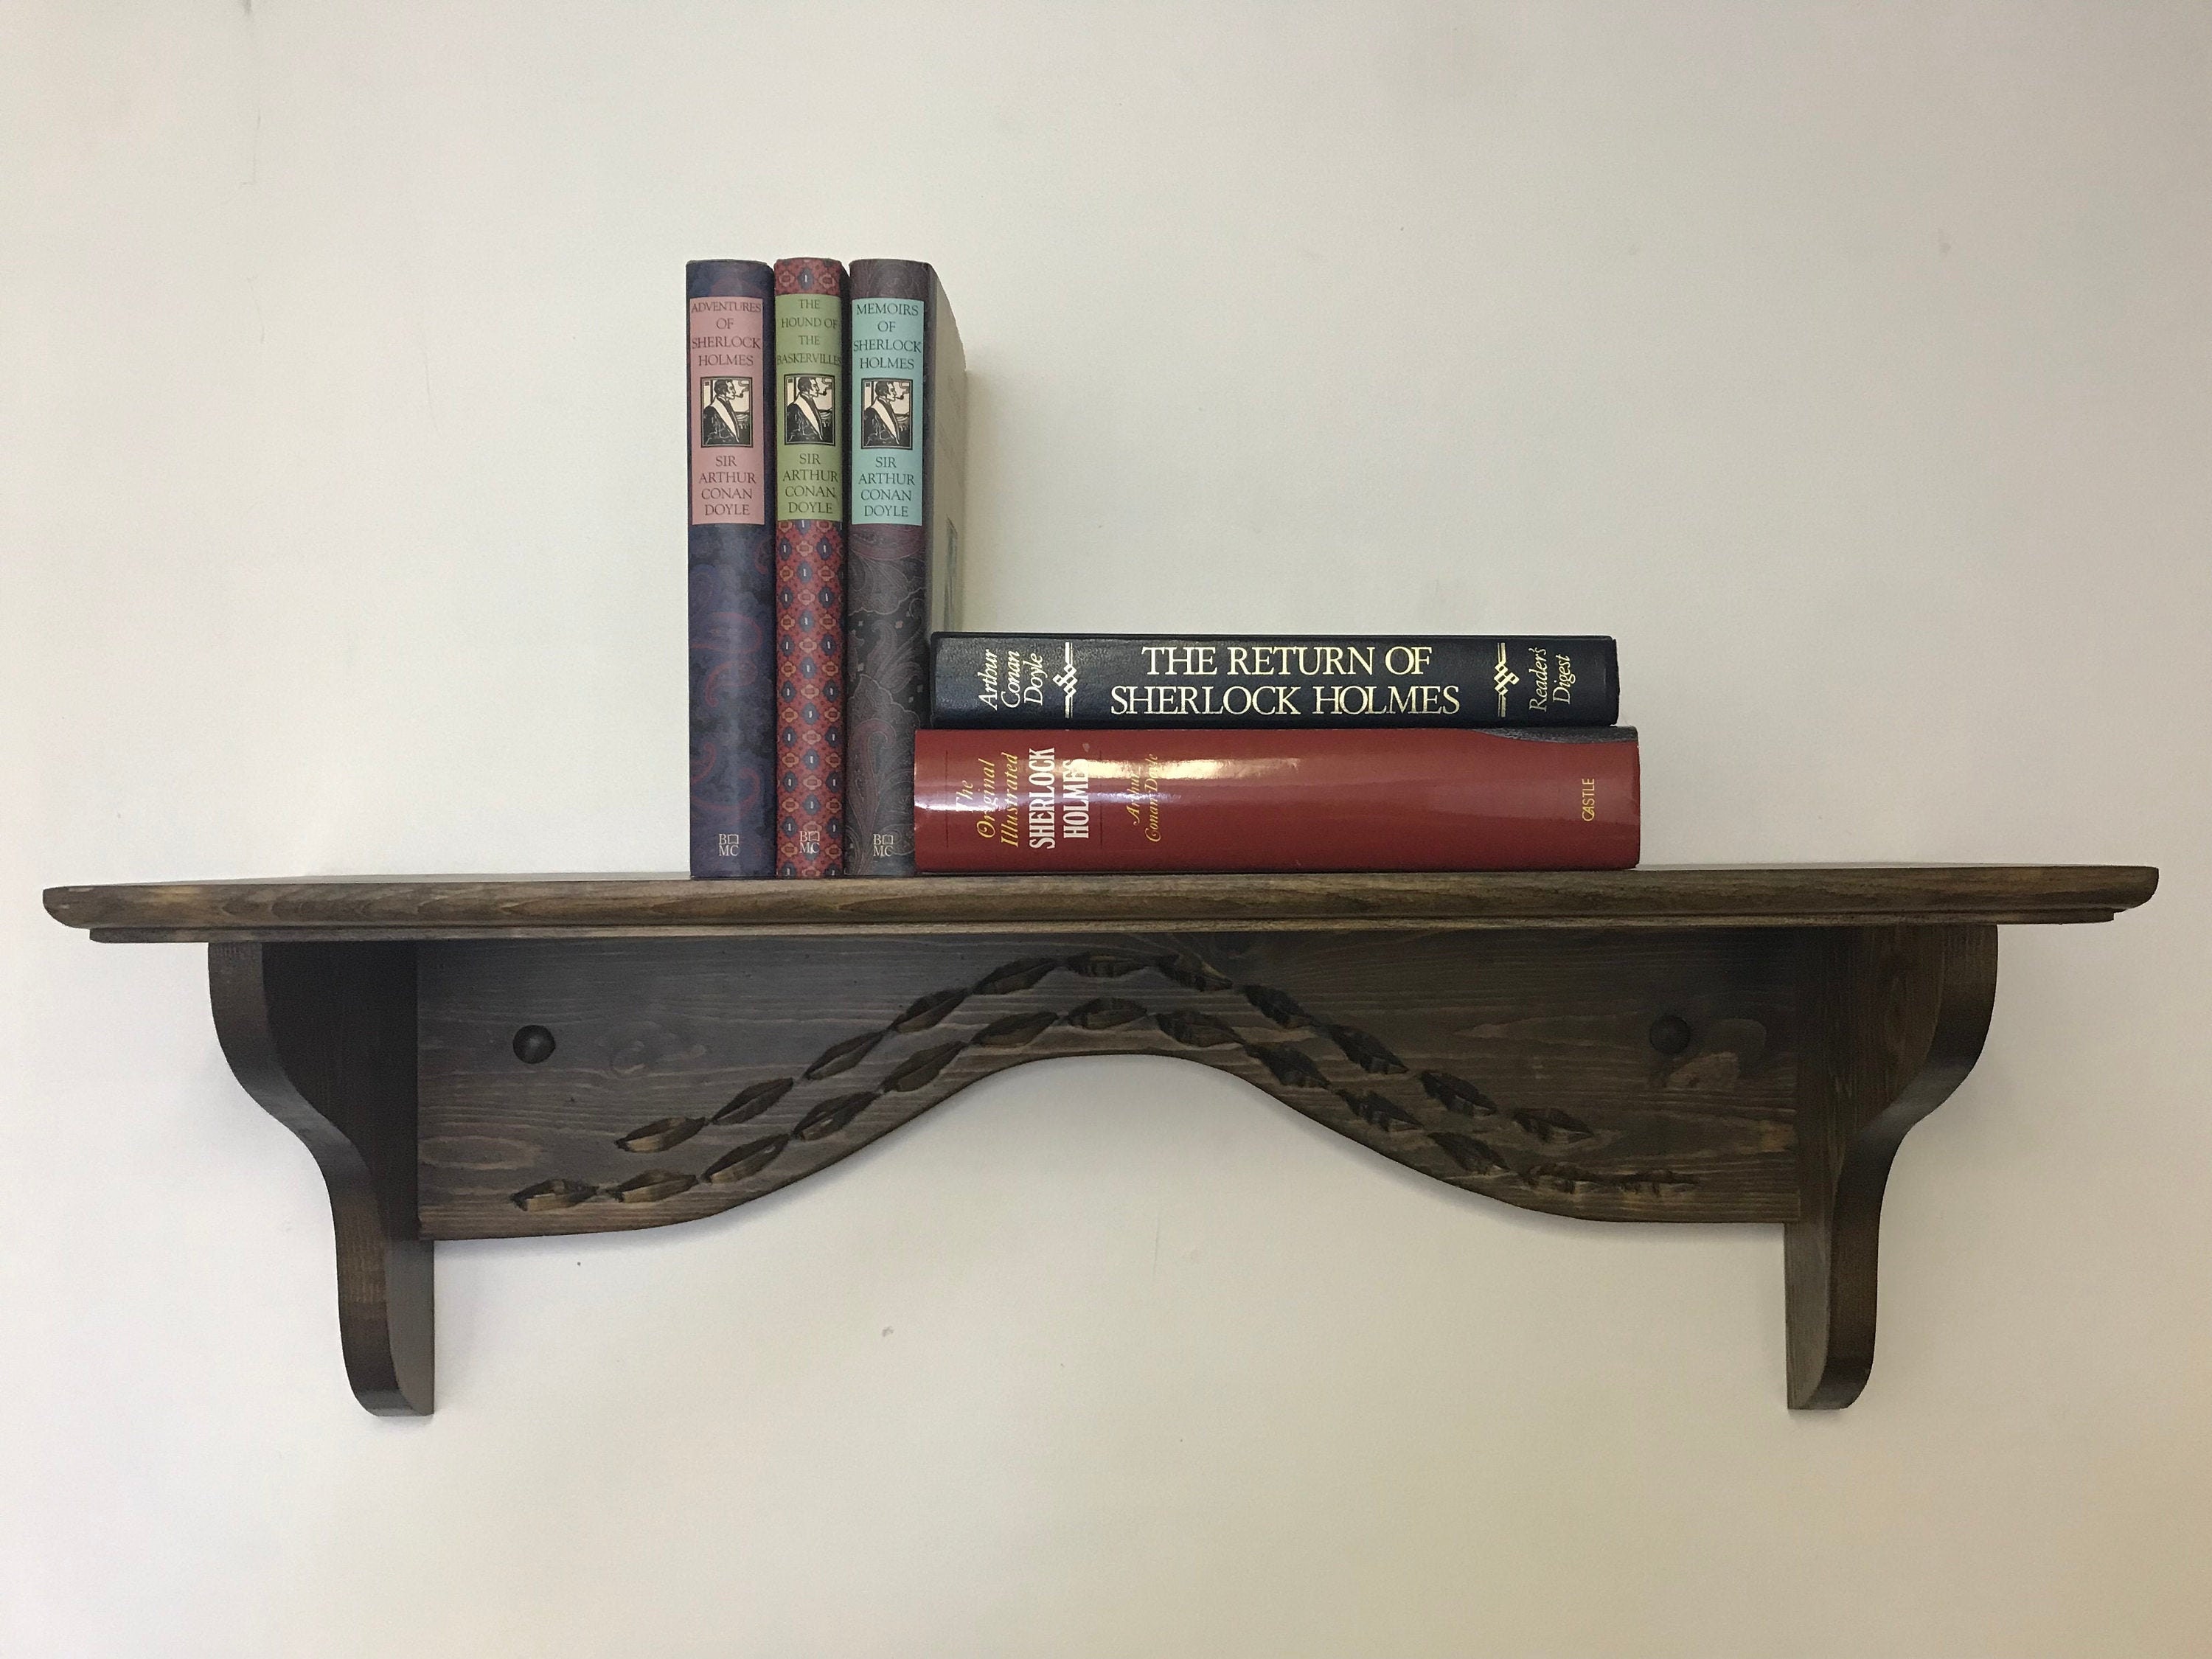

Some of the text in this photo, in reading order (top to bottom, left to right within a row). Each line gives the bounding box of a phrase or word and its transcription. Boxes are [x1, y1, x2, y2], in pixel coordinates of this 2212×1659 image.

[691, 302, 762, 313] ADVENTURES
[799, 299, 820, 309] THE
[856, 303, 919, 316] MEMOIRS
[716, 319, 734, 330] OF
[782, 317, 838, 328] HOUND OF
[877, 321, 896, 332] OF
[692, 336, 761, 349] SHERLOCK
[799, 335, 820, 345] THE
[854, 340, 922, 352] SHERLOCK
[698, 355, 754, 366] HOLMES
[776, 354, 842, 366] BASKERVILLES
[860, 358, 914, 369] HOLMES
[715, 455, 737, 467] SIR
[799, 453, 821, 465] SIR
[875, 456, 897, 467] SIR
[700, 472, 756, 484] ARTHUR
[782, 470, 838, 481] ARTHUR
[858, 473, 915, 485] ARTHUR
[701, 488, 752, 499] CONAN
[785, 486, 835, 498] CONAN
[860, 490, 911, 501] CONAN
[705, 504, 750, 515] DOYLE
[788, 502, 832, 513] DOYLE
[864, 506, 908, 517] DOYLE
[1141, 646, 1433, 675] THE RETURN OF
[978, 649, 997, 710] Arthur
[1001, 650, 1020, 708] Conan
[1023, 653, 1048, 706] Doyle
[1528, 647, 1548, 712] Reader's
[1553, 654, 1576, 703] Digest
[1110, 686, 1461, 715] SHERLOCK HOLMES
[956, 780, 973, 812] The
[977, 758, 996, 838] Orginal
[1001, 752, 1018, 847] Illustrated
[1029, 747, 1055, 849] SHERLOCK
[1062, 759, 1089, 838] HOLMES
[1582, 777, 1595, 821] CASTLE
[1144, 796, 1161, 842] Conan
[718, 846, 739, 856] MC
[799, 842, 820, 853] MC
[873, 846, 893, 857] MC
